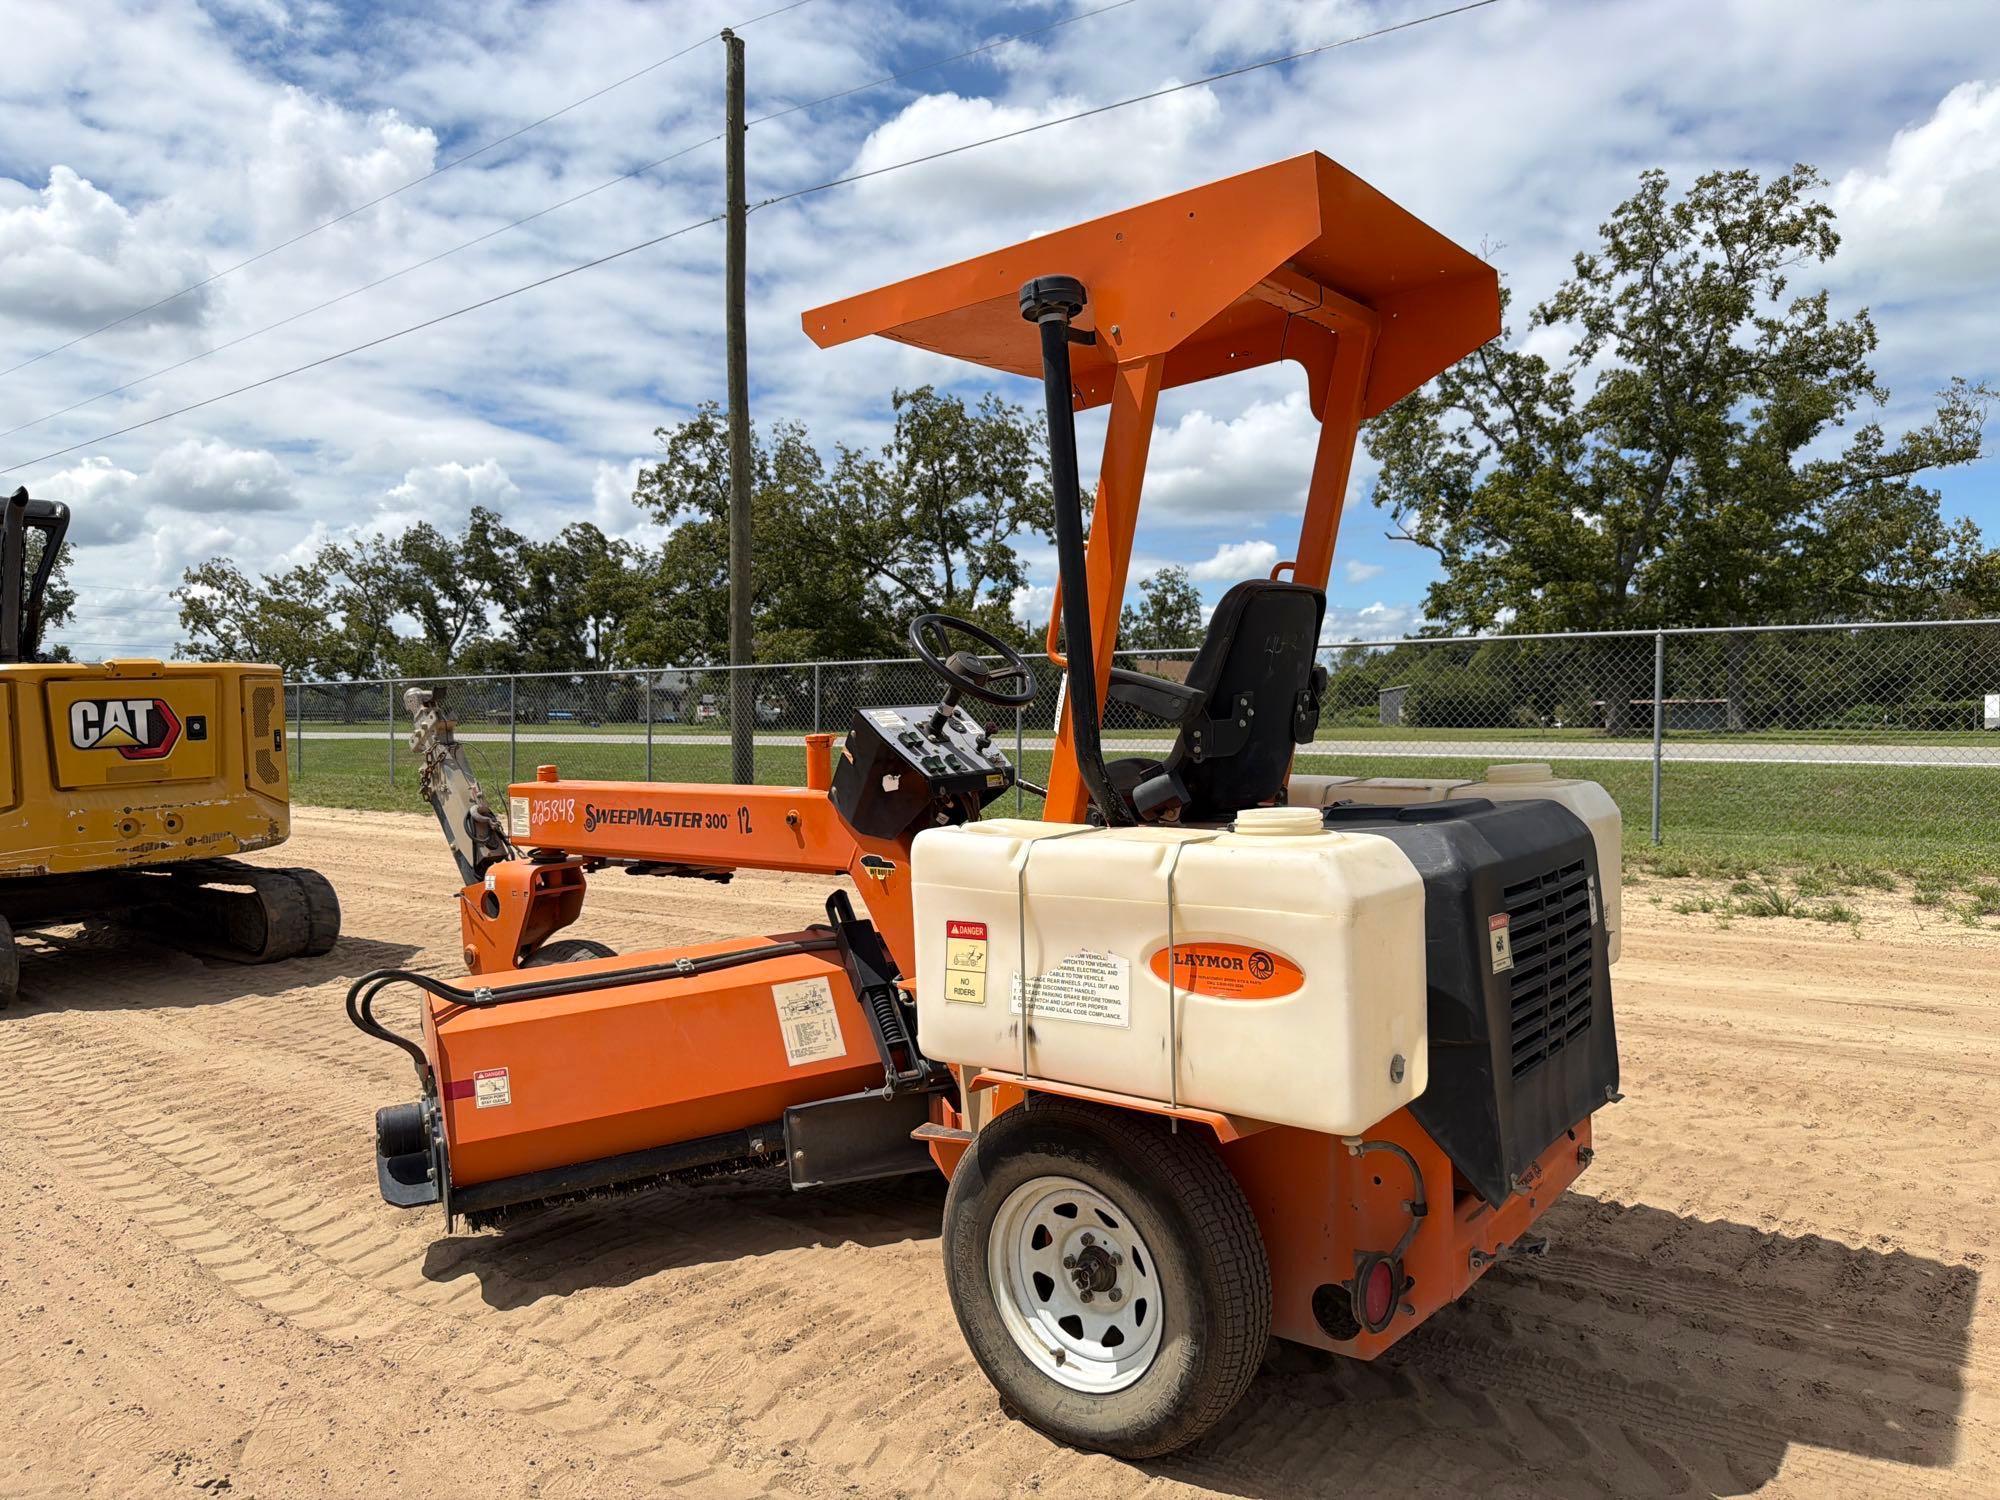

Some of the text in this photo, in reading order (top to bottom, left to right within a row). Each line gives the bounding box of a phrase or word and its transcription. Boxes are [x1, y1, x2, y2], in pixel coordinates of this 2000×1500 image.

[71, 700, 153, 748] CAT
[531, 798, 575, 826] 225848
[705, 813, 728, 829] 300
[737, 806, 753, 834] 12
[959, 925, 984, 936] DANGER
[1174, 953, 1244, 970] LAYMOR
[1077, 967, 1106, 975] ELECTRICAL
[960, 978, 970, 986] NO
[1082, 981, 1097, 989] (PULL
[953, 987, 976, 997] RIDERS
[1043, 984, 1074, 993] DISCONNECT
[1042, 991, 1063, 999] PARKING
[1081, 995, 1101, 1003] BEFORE
[1087, 1003, 1108, 1011] PROPER
